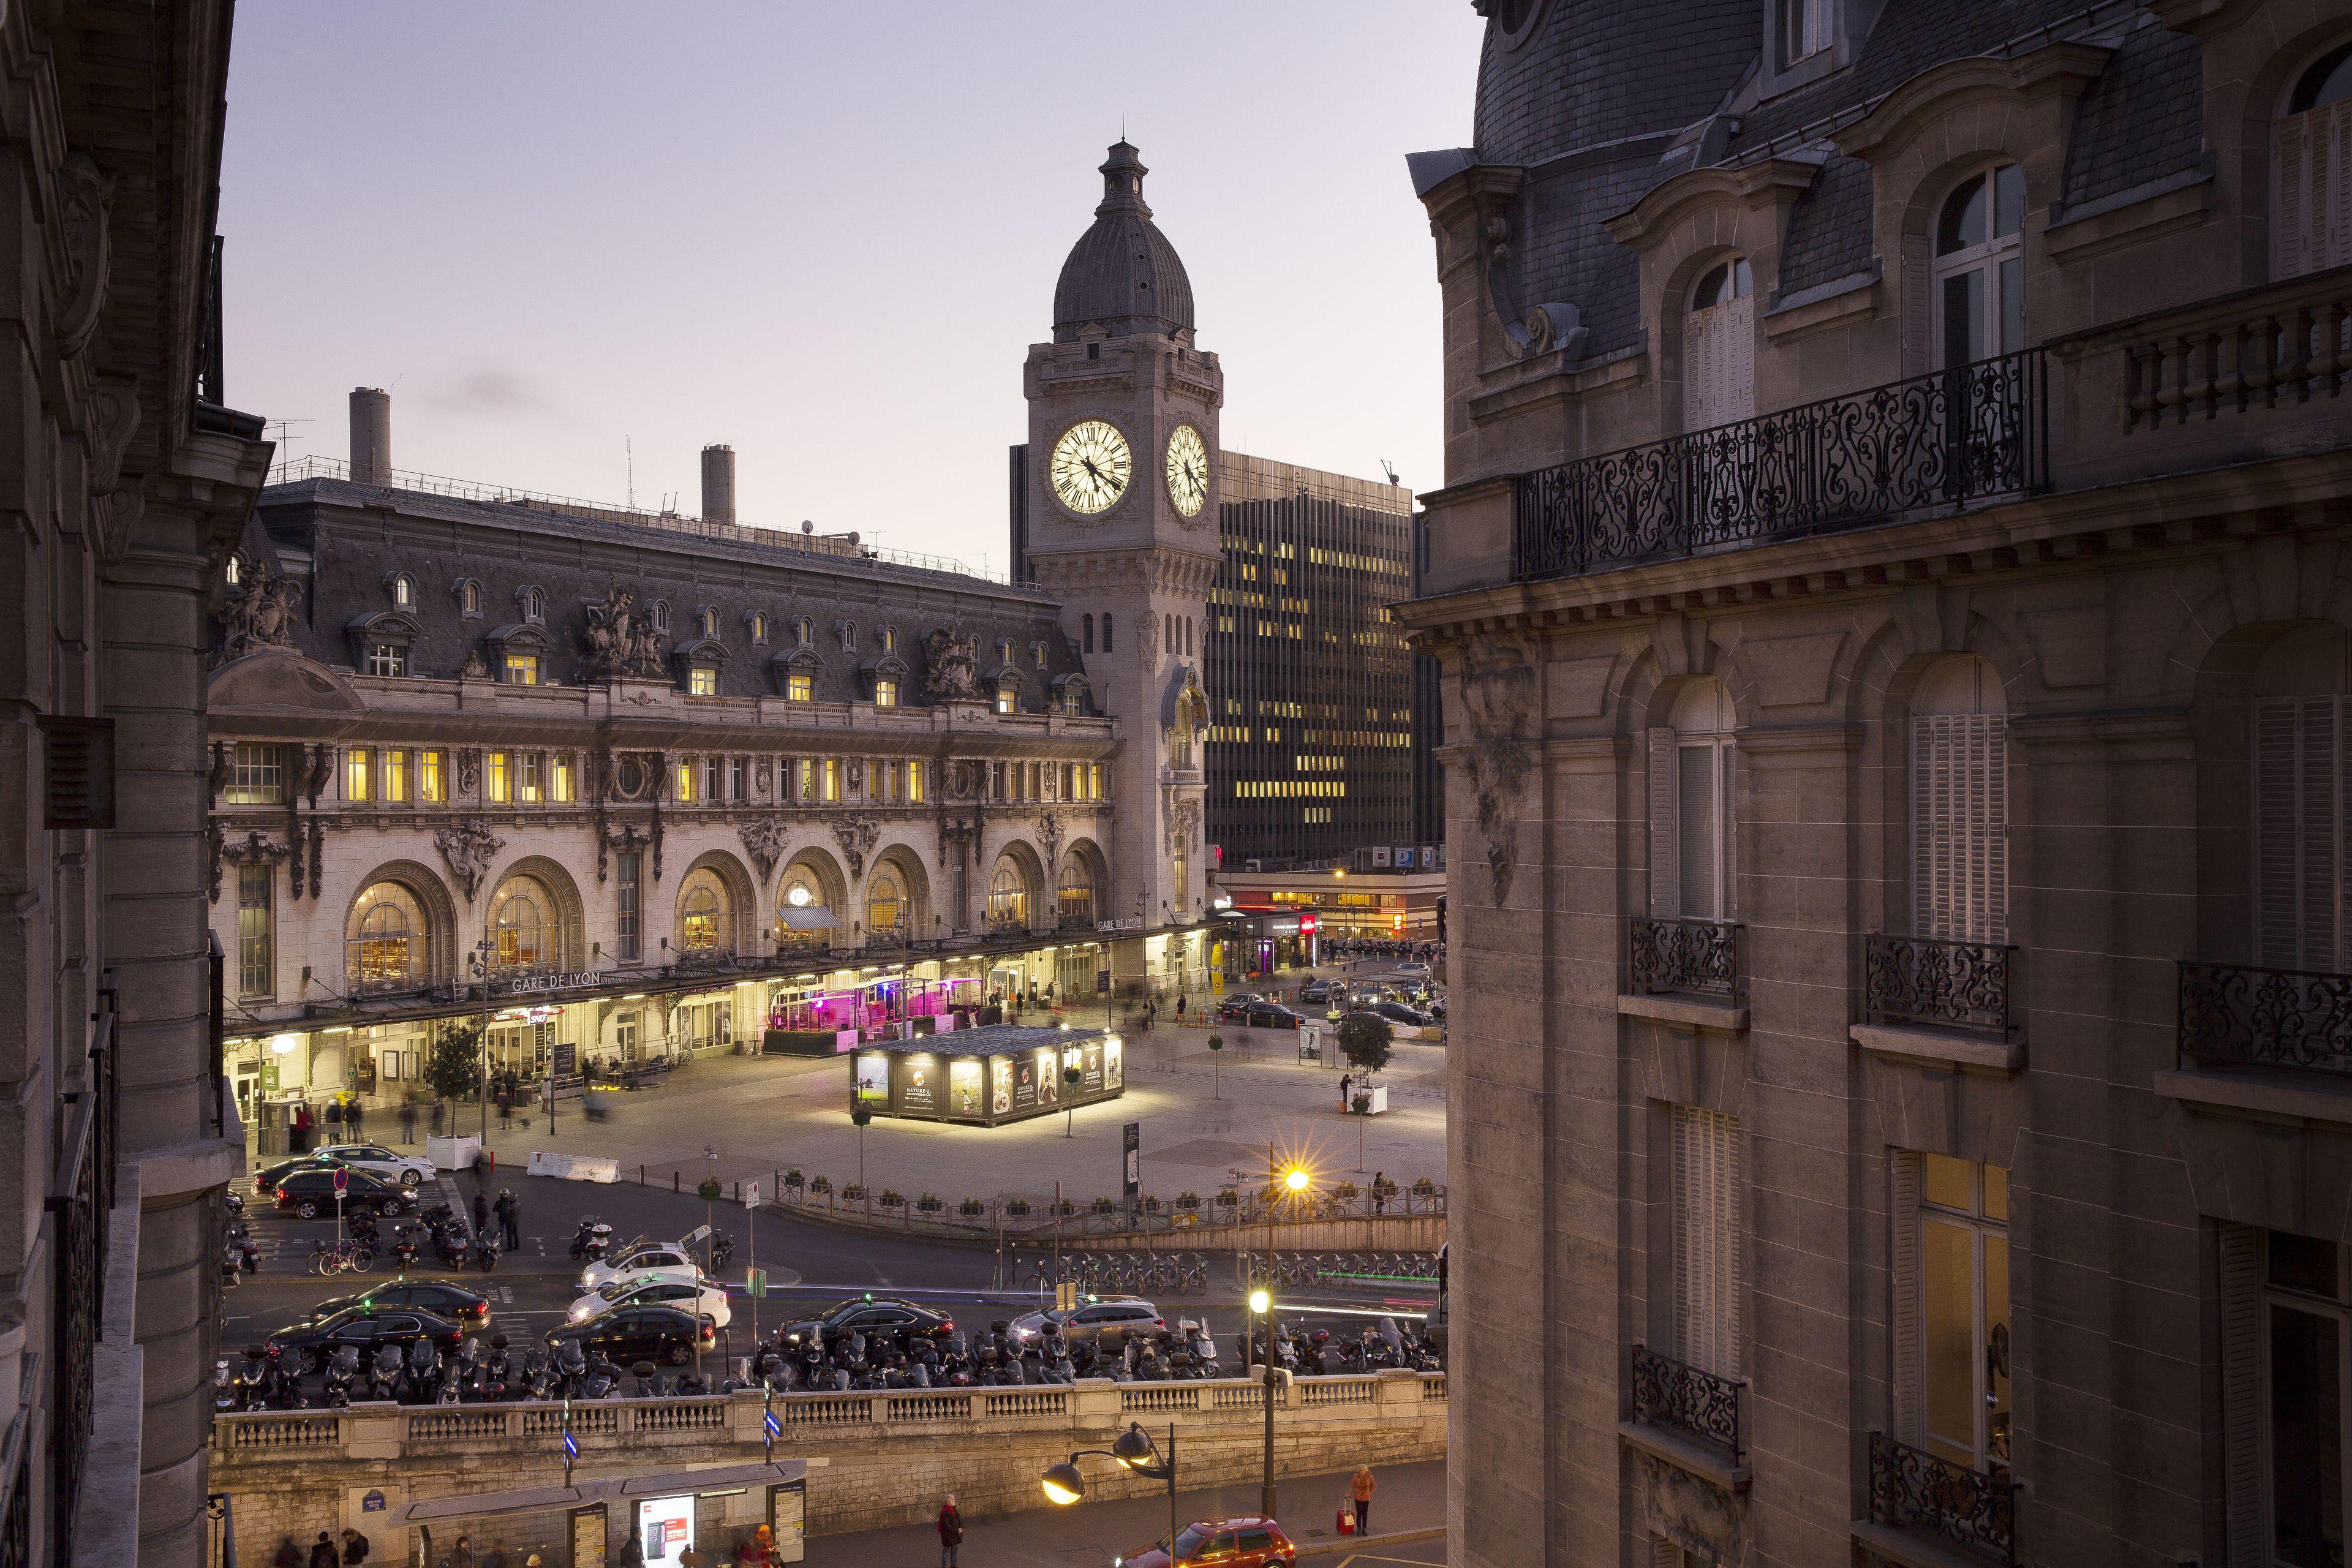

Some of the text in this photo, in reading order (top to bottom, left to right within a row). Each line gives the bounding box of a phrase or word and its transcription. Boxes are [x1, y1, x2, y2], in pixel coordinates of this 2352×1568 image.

[1098, 918, 1141, 930] GARE DE LYON
[513, 972, 600, 992] GARE DE LYON
[530, 1014, 548, 1023] SNCF
